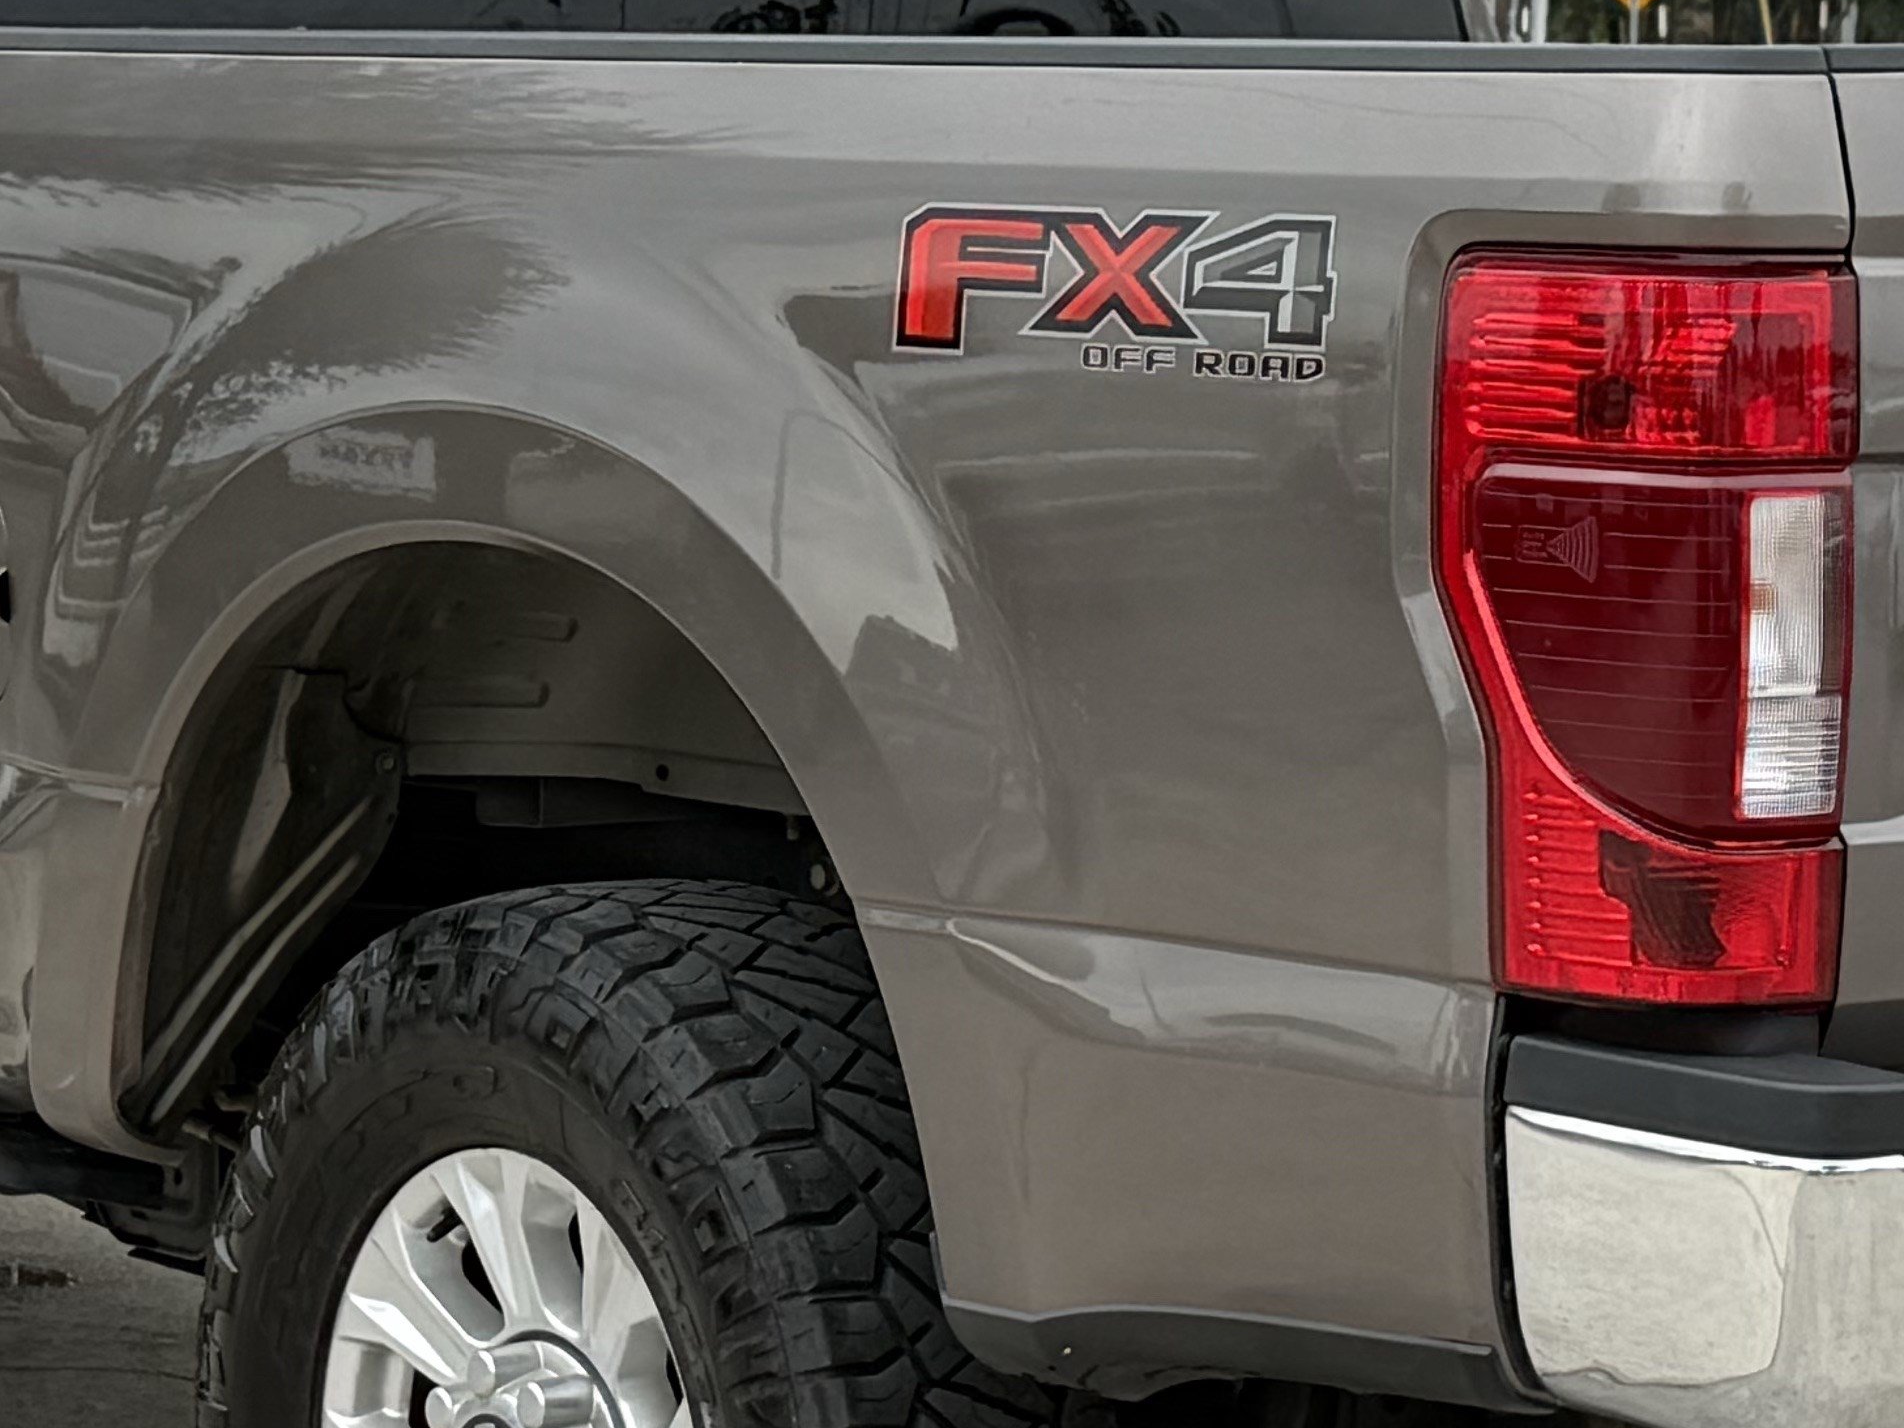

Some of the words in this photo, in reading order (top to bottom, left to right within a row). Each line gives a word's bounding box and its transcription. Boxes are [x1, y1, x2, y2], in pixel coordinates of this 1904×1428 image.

[892, 202, 1337, 355] FX4
[1081, 343, 1176, 374] OFF
[1193, 346, 1327, 382] ROAD
